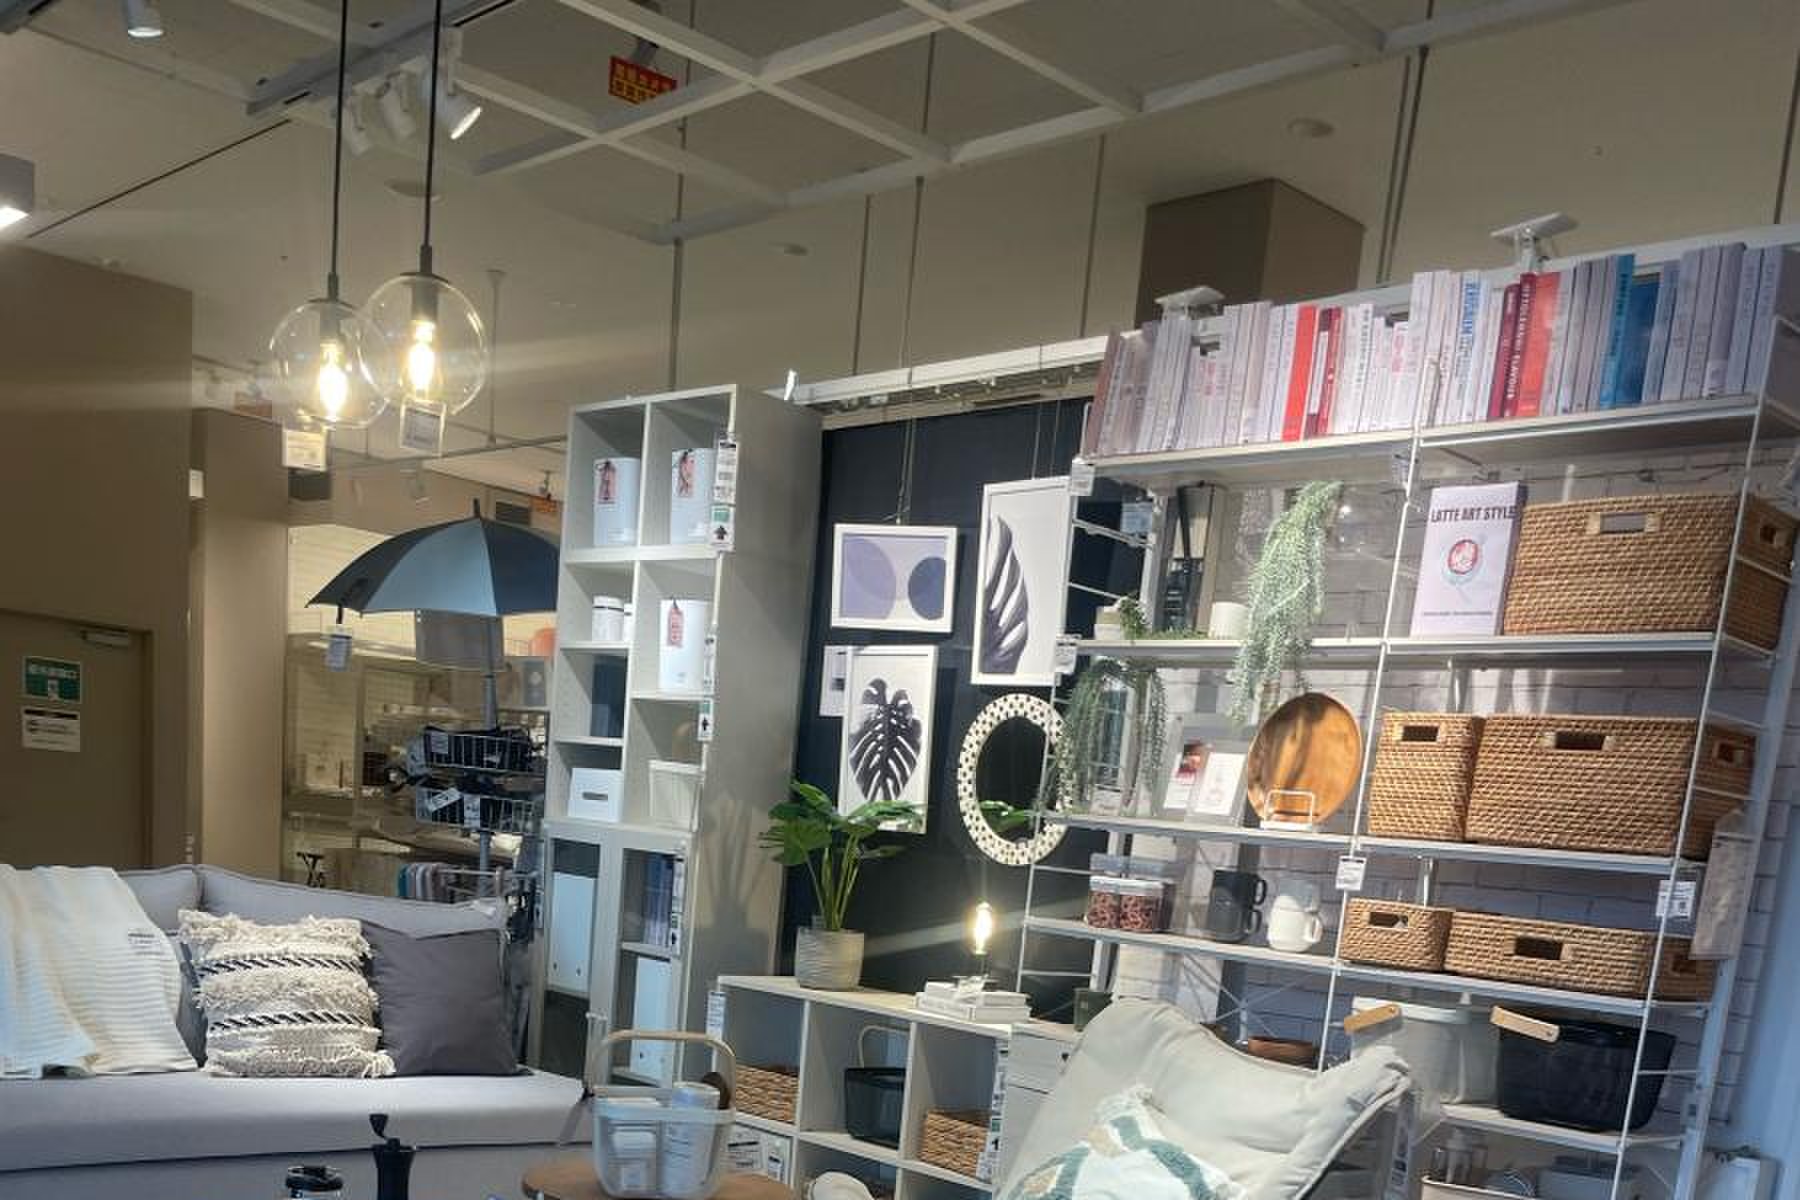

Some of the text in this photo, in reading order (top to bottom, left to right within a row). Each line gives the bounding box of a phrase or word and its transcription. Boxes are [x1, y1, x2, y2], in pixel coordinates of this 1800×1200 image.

[1430, 504, 1518, 523] LATTE ART STYLE
